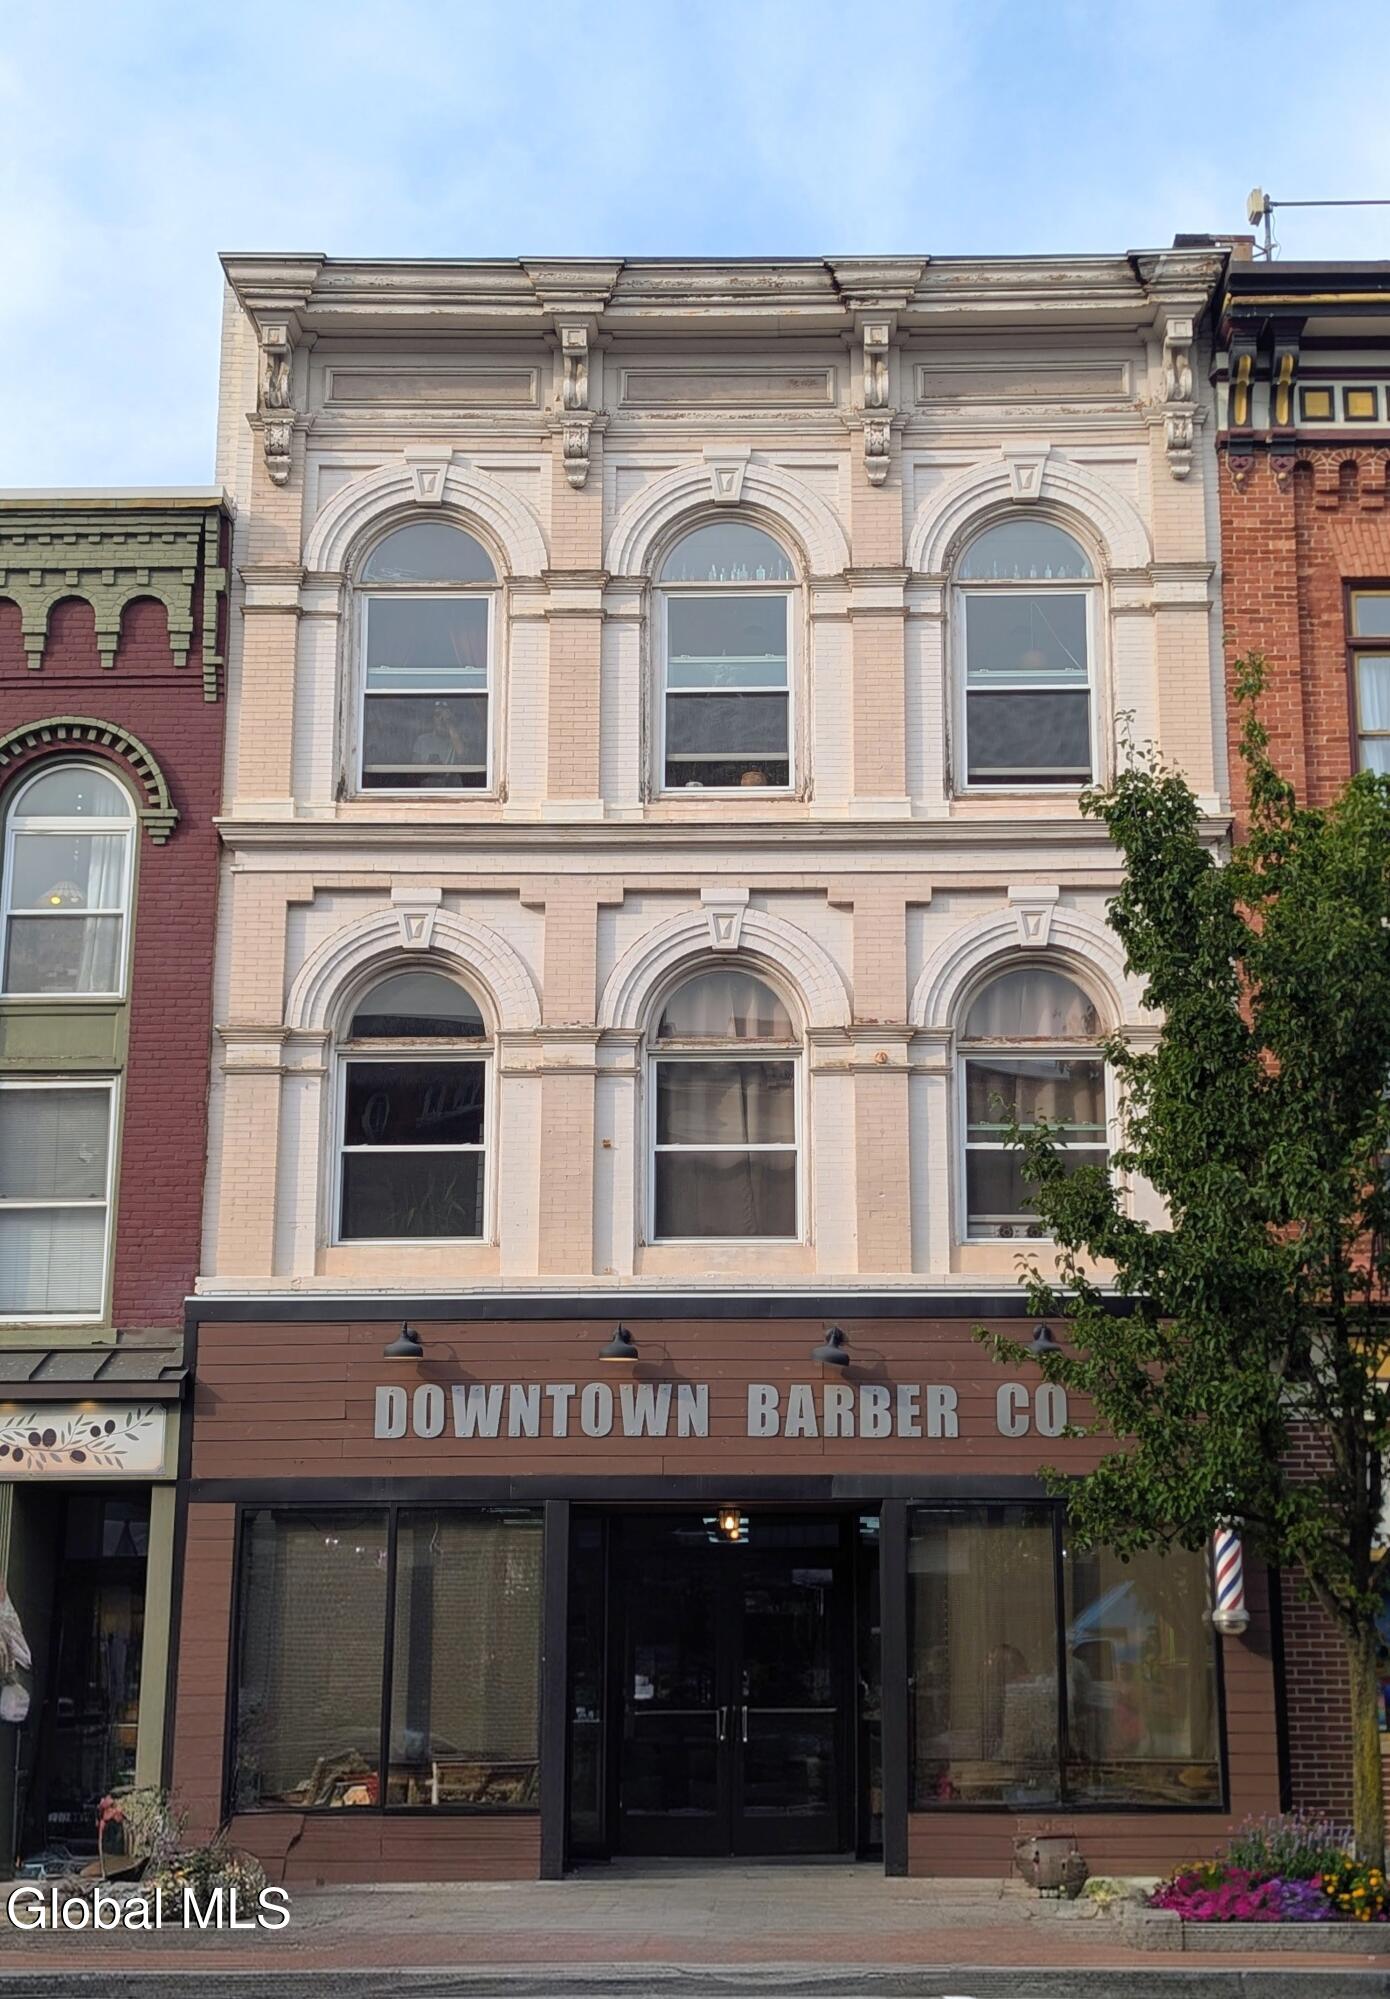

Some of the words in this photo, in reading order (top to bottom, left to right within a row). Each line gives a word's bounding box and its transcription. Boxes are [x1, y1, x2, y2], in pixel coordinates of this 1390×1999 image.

[374, 1383, 709, 1439] DOWNTOWN
[747, 1383, 959, 1438] BARBER
[996, 1382, 1068, 1438] CO
